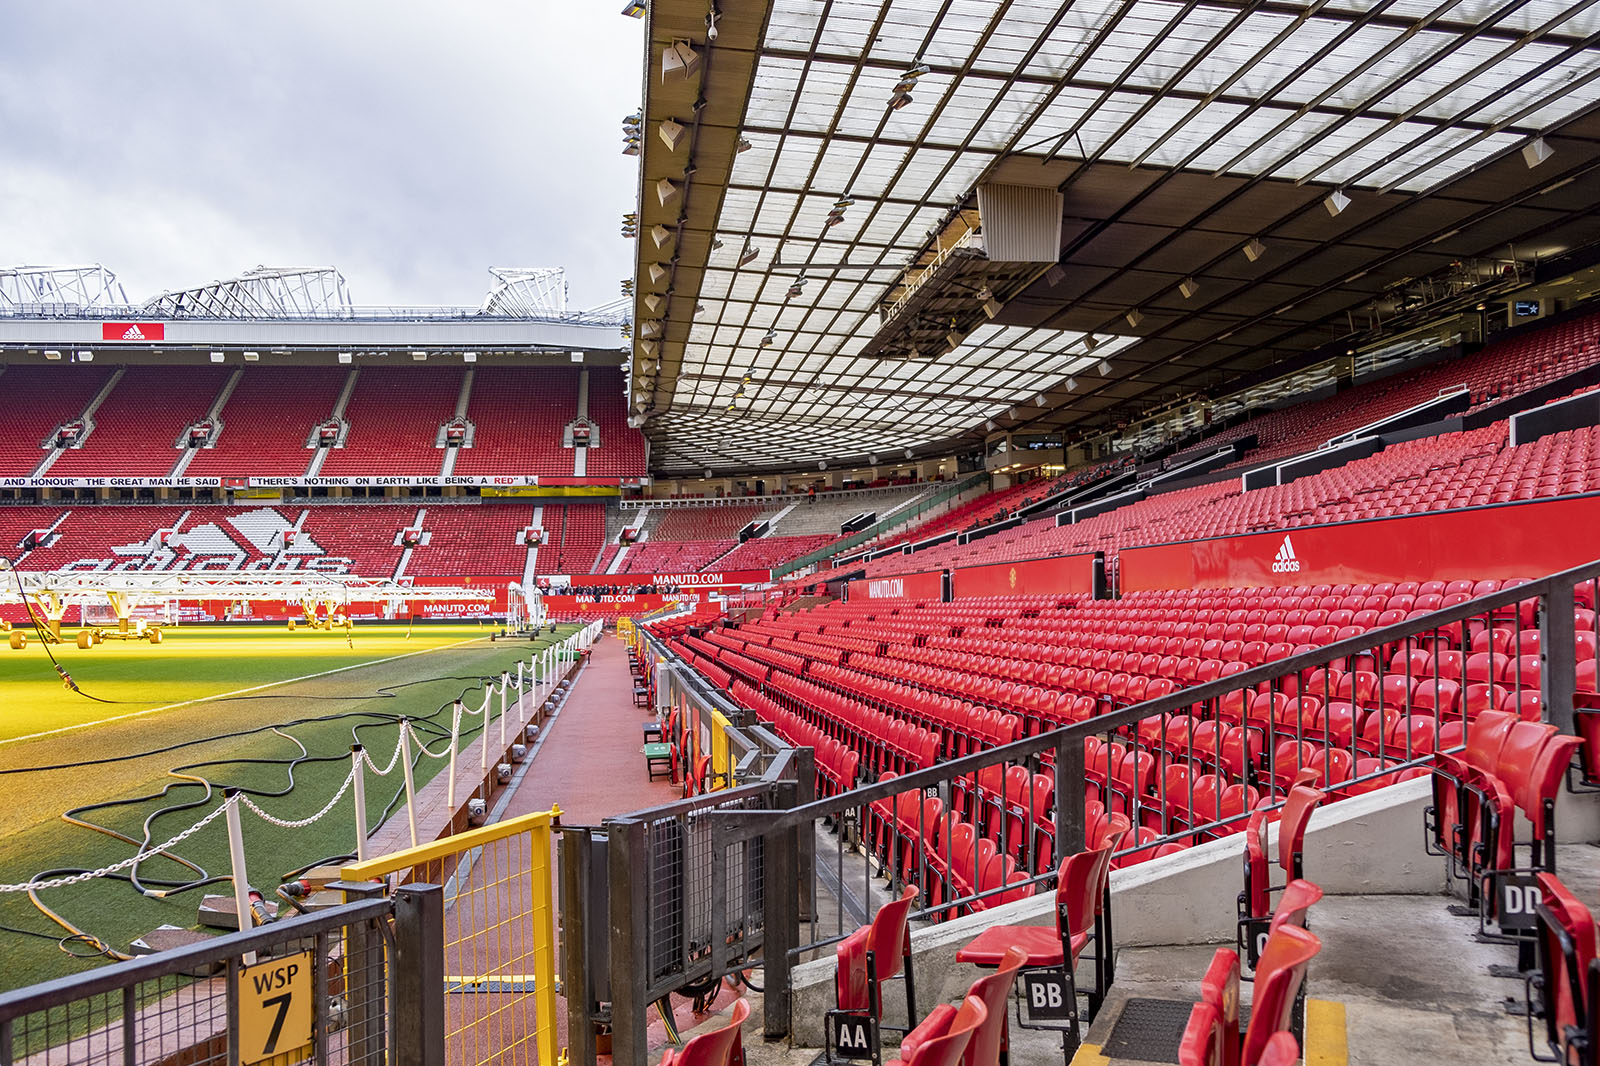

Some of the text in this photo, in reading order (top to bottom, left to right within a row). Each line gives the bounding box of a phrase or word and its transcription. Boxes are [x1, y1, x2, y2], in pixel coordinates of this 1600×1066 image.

[122, 332, 146, 340] adidas
[3, 478, 219, 486] AND HONOUR" THE GREAT MAN HE SAID
[251, 477, 298, 486] "THERE'S
[304, 477, 349, 485] NOTHING
[355, 477, 370, 485] ON
[376, 477, 410, 485] EARTH
[416, 477, 439, 485] LIKE
[445, 477, 474, 485] BEING
[480, 477, 488, 485] A
[1272, 559, 1301, 573] adidas
[653, 573, 723, 585] MANUTD.COM
[869, 578, 904, 598] MANUTD.COM
[423, 603, 491, 613] MANUTD.COM
[927, 787, 938, 798] BB
[844, 807, 856, 817] AA
[1505, 885, 1542, 914] DD
[253, 964, 298, 995] WSP
[1031, 981, 1063, 1009] BB
[262, 992, 292, 1055] 7
[839, 1022, 868, 1050] AA
